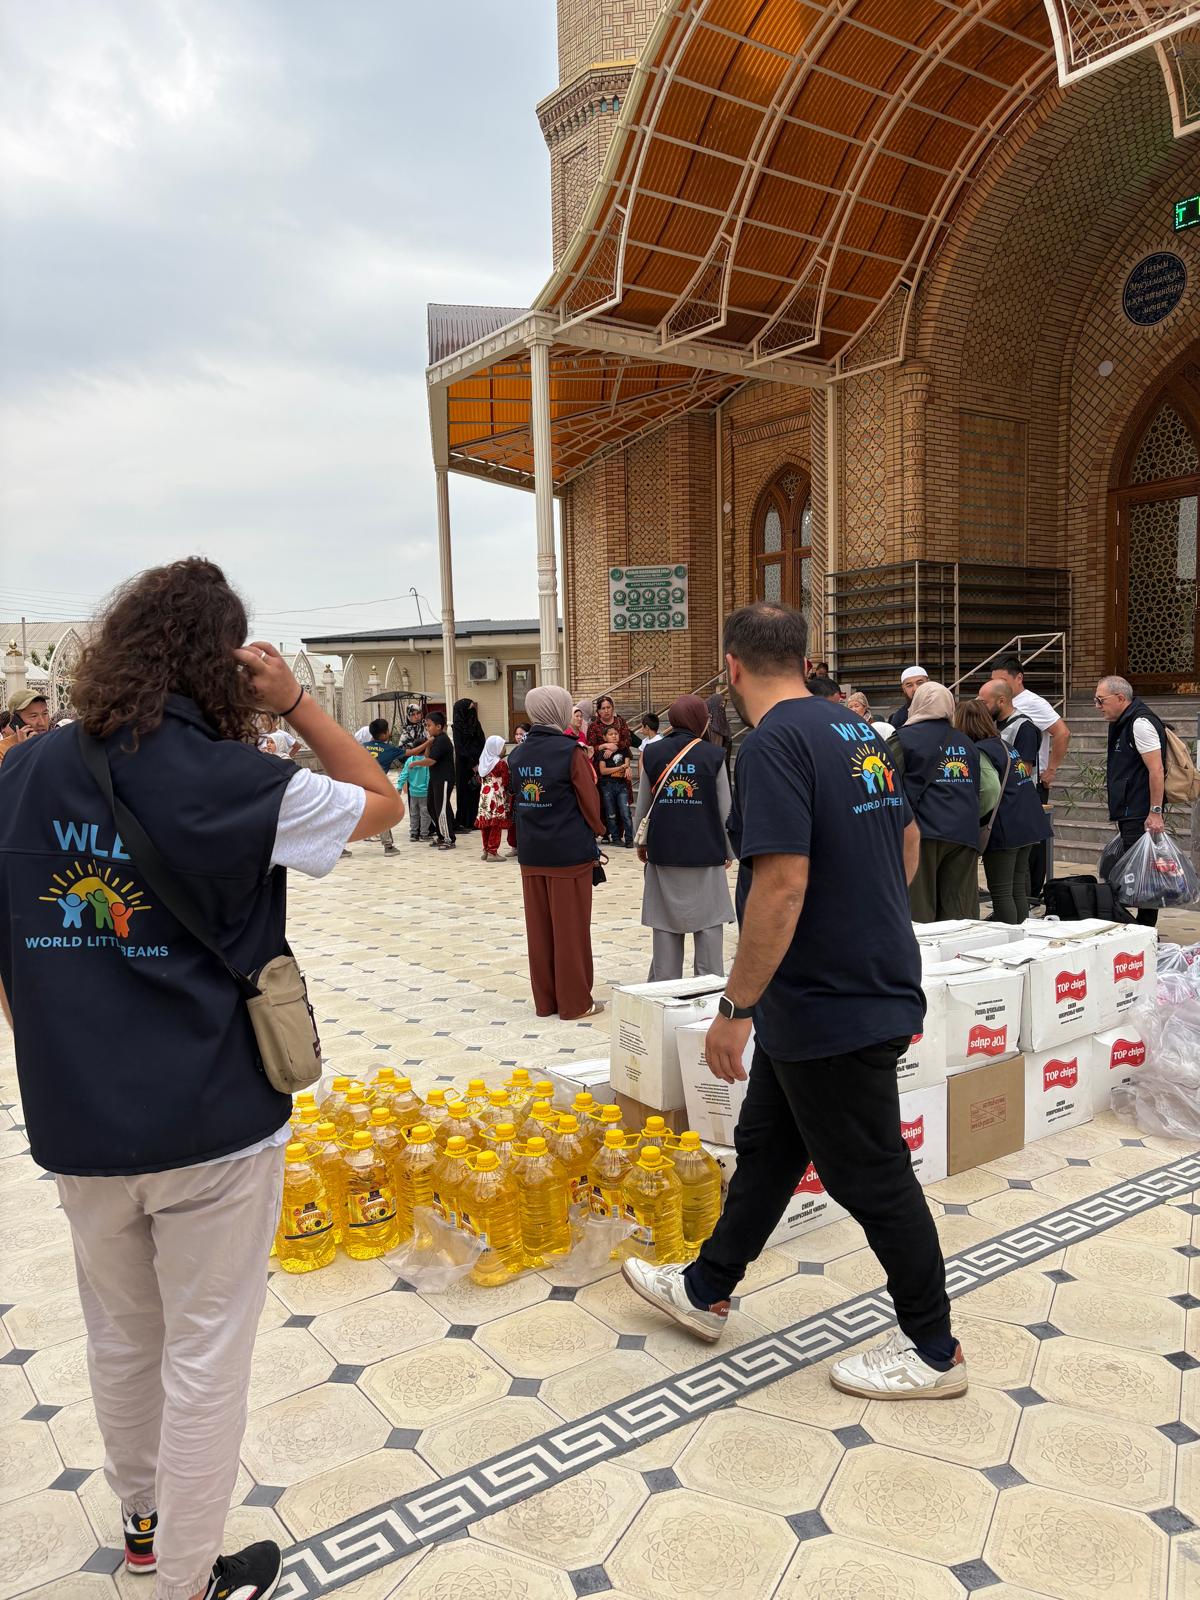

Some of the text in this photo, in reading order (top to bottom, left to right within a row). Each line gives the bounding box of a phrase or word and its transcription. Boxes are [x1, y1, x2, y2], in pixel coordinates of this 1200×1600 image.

[830, 722, 876, 742] WLB
[519, 766, 542, 777] WLB
[853, 800, 880, 814] WORD
[25, 935, 122, 949] WORLD LITTL
[1115, 960, 1143, 974] TOP chips
[1057, 979, 1086, 993] TOP chips
[970, 1035, 1005, 1049] TOP chips
[1113, 1046, 1145, 1060] TOP chips
[1045, 1066, 1077, 1082] TOP chips
[901, 1126, 922, 1140] chips
